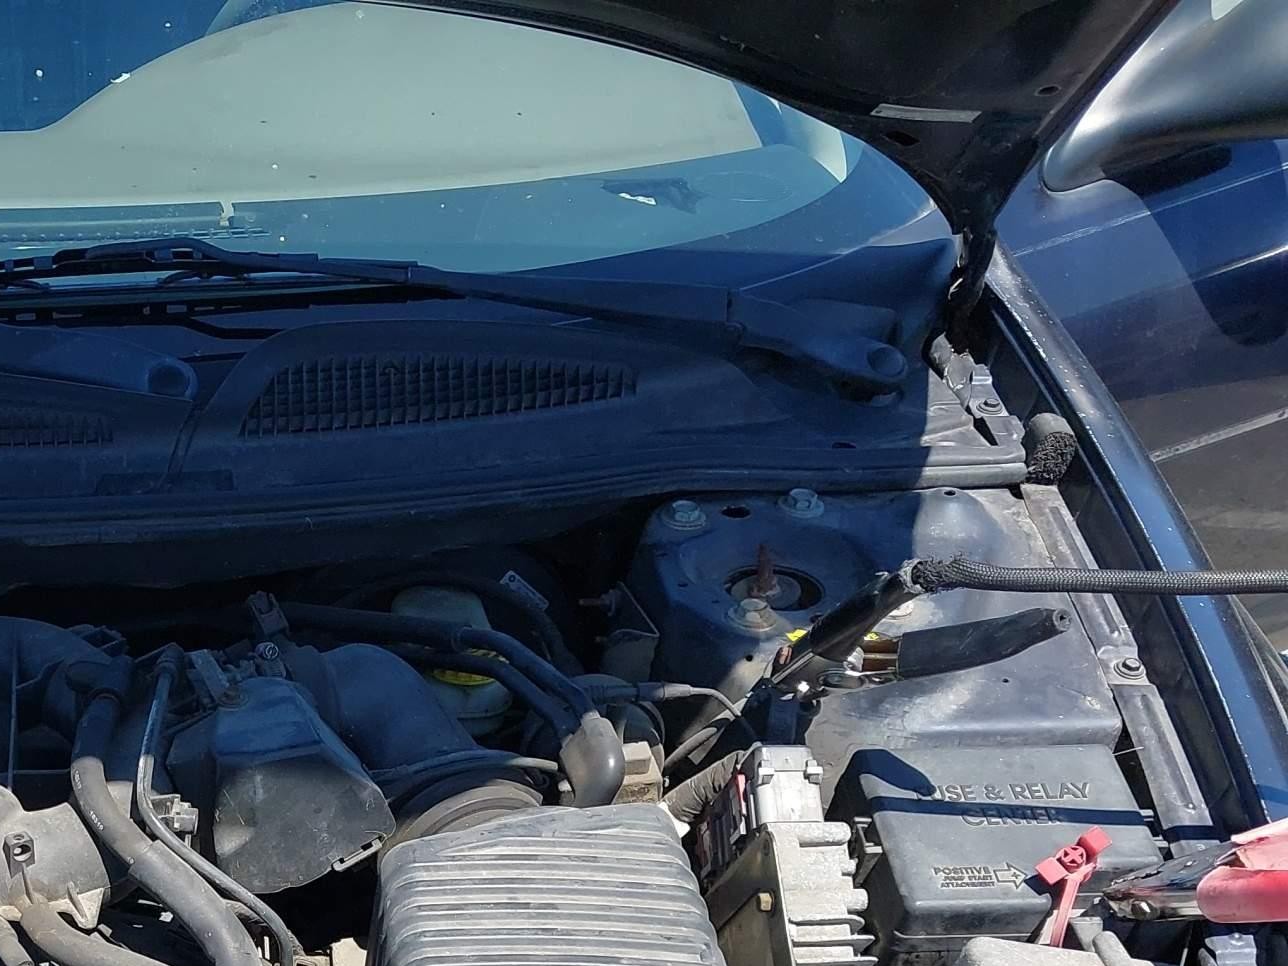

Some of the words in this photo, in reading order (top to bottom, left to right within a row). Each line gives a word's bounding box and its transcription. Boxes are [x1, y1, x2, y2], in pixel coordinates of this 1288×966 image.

[916, 784, 977, 801] USE
[984, 784, 1005, 800] &
[1009, 782, 1089, 800] RELAY
[962, 807, 1062, 826] CENTER
[932, 866, 992, 876] POSITIVE
